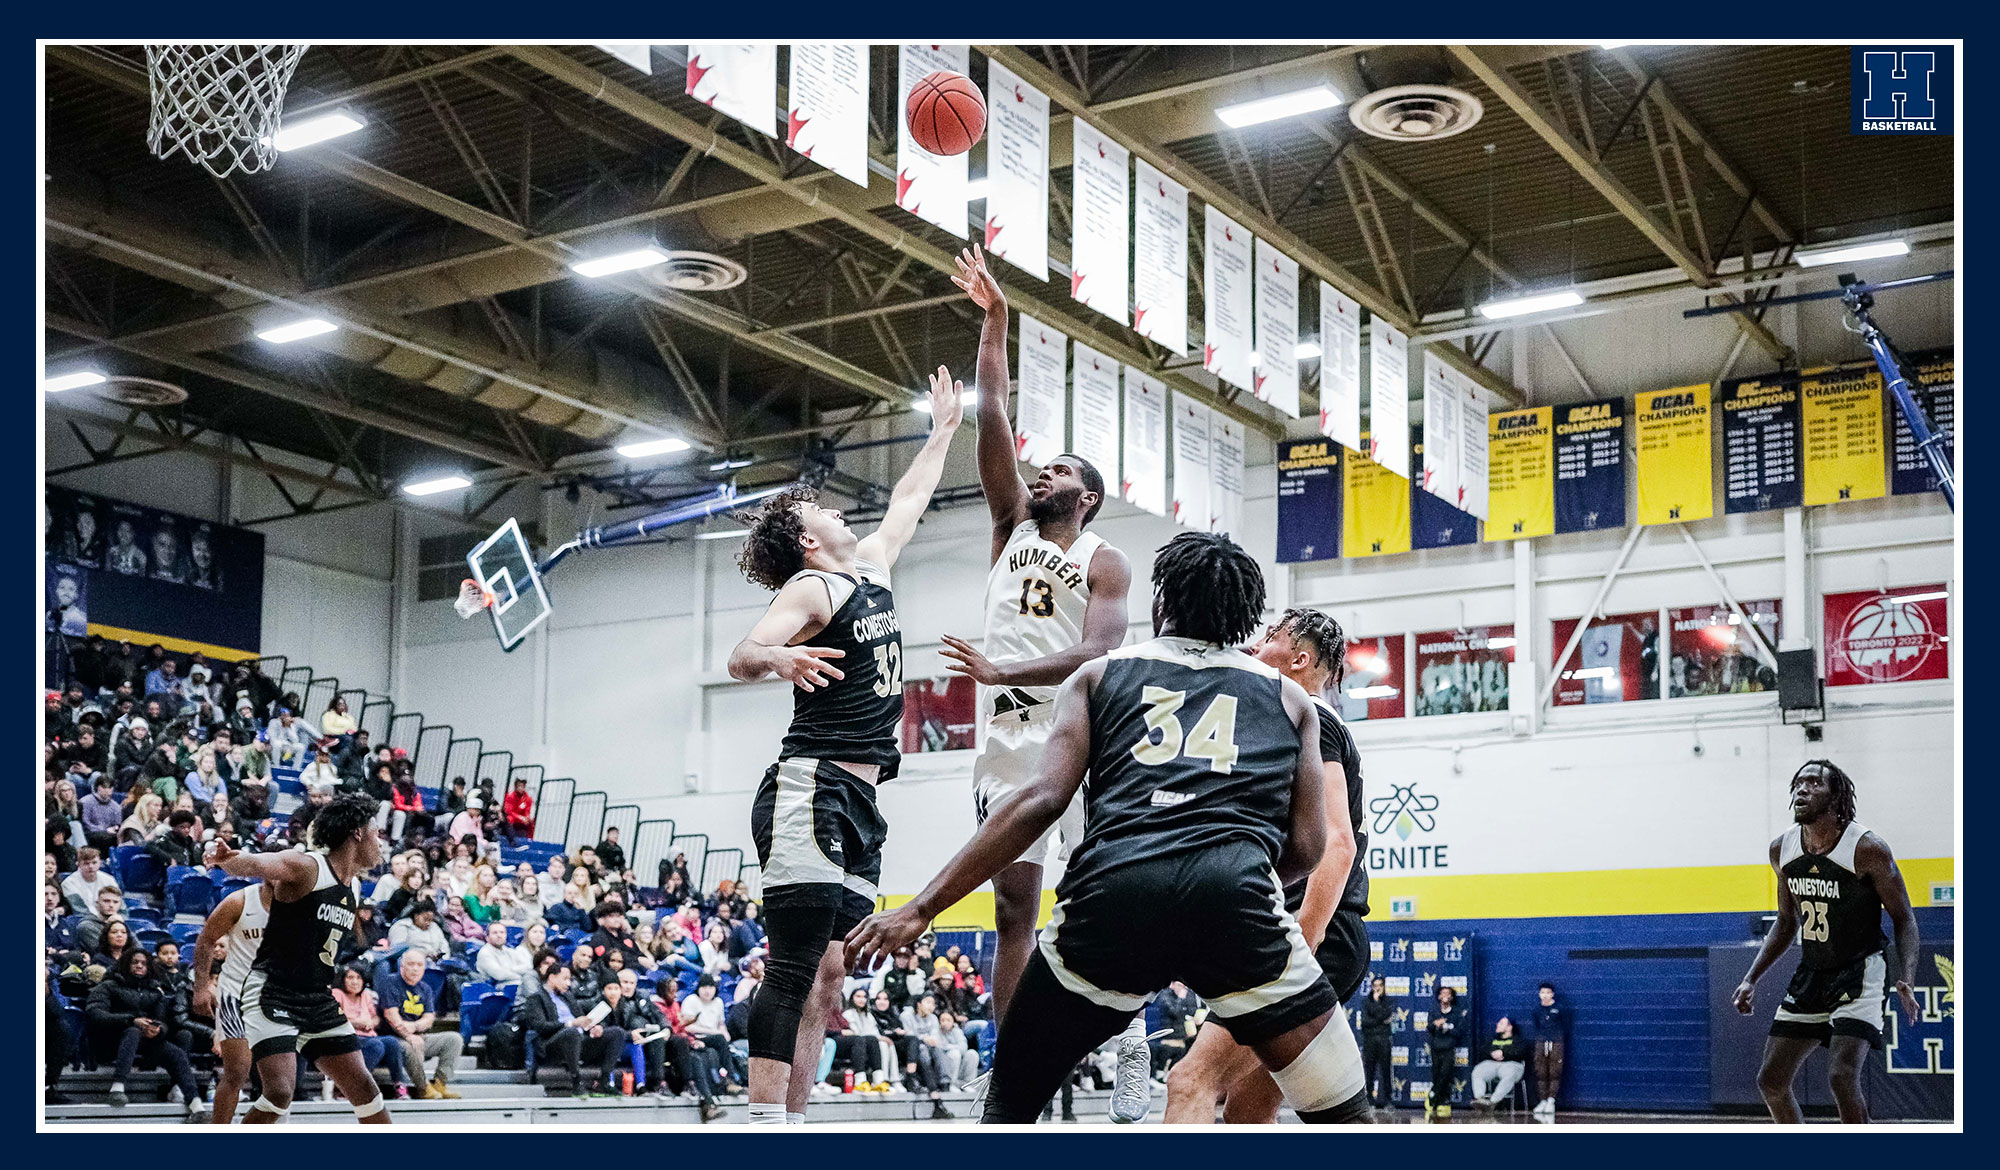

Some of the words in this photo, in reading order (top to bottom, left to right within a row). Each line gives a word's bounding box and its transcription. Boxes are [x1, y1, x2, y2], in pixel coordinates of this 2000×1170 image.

[1806, 380, 1878, 398] CHAMPIONS
[1651, 392, 1694, 410] OCAA
[1724, 391, 1796, 410] CHAMPIONS
[1497, 413, 1538, 430] OCAA
[1568, 403, 1611, 423] OCAA
[1639, 405, 1706, 422] CHAMPIONS
[1556, 416, 1622, 435] CHAMPIONS
[1279, 455, 1337, 470] CHAMPIONS
[1009, 548, 1083, 590] HUMBER
[1019, 577, 1055, 618] 13
[1420, 641, 1468, 654] NATIONAL
[1849, 638, 1896, 650] TORONTO
[1898, 635, 1924, 646] 2022
[873, 641, 902, 698] 32
[1130, 685, 1239, 775] 34
[1370, 845, 1448, 870] GNITE
[1788, 878, 1840, 899] CONESTOGA
[1801, 901, 1829, 942] 23
[319, 928, 343, 967] 5
